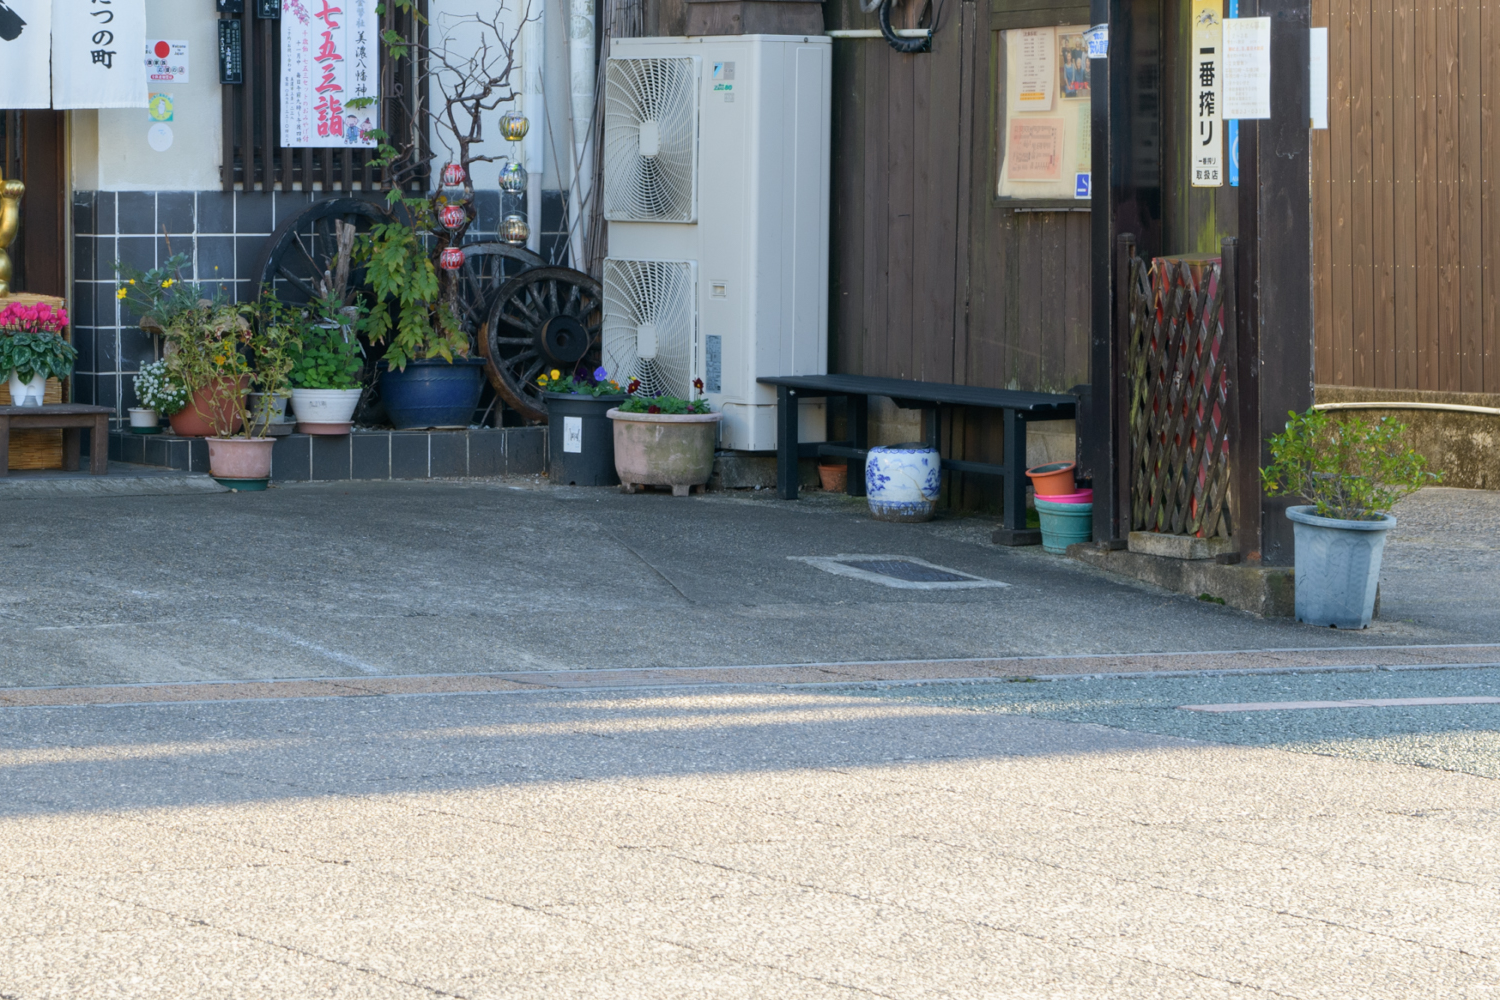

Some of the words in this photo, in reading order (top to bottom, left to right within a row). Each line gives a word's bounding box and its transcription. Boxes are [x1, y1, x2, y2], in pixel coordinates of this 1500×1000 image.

[314, 0, 344, 137] 七五三詣
[1199, 47, 1215, 146] 一番搾り
[1196, 169, 1219, 180] 取扱店
